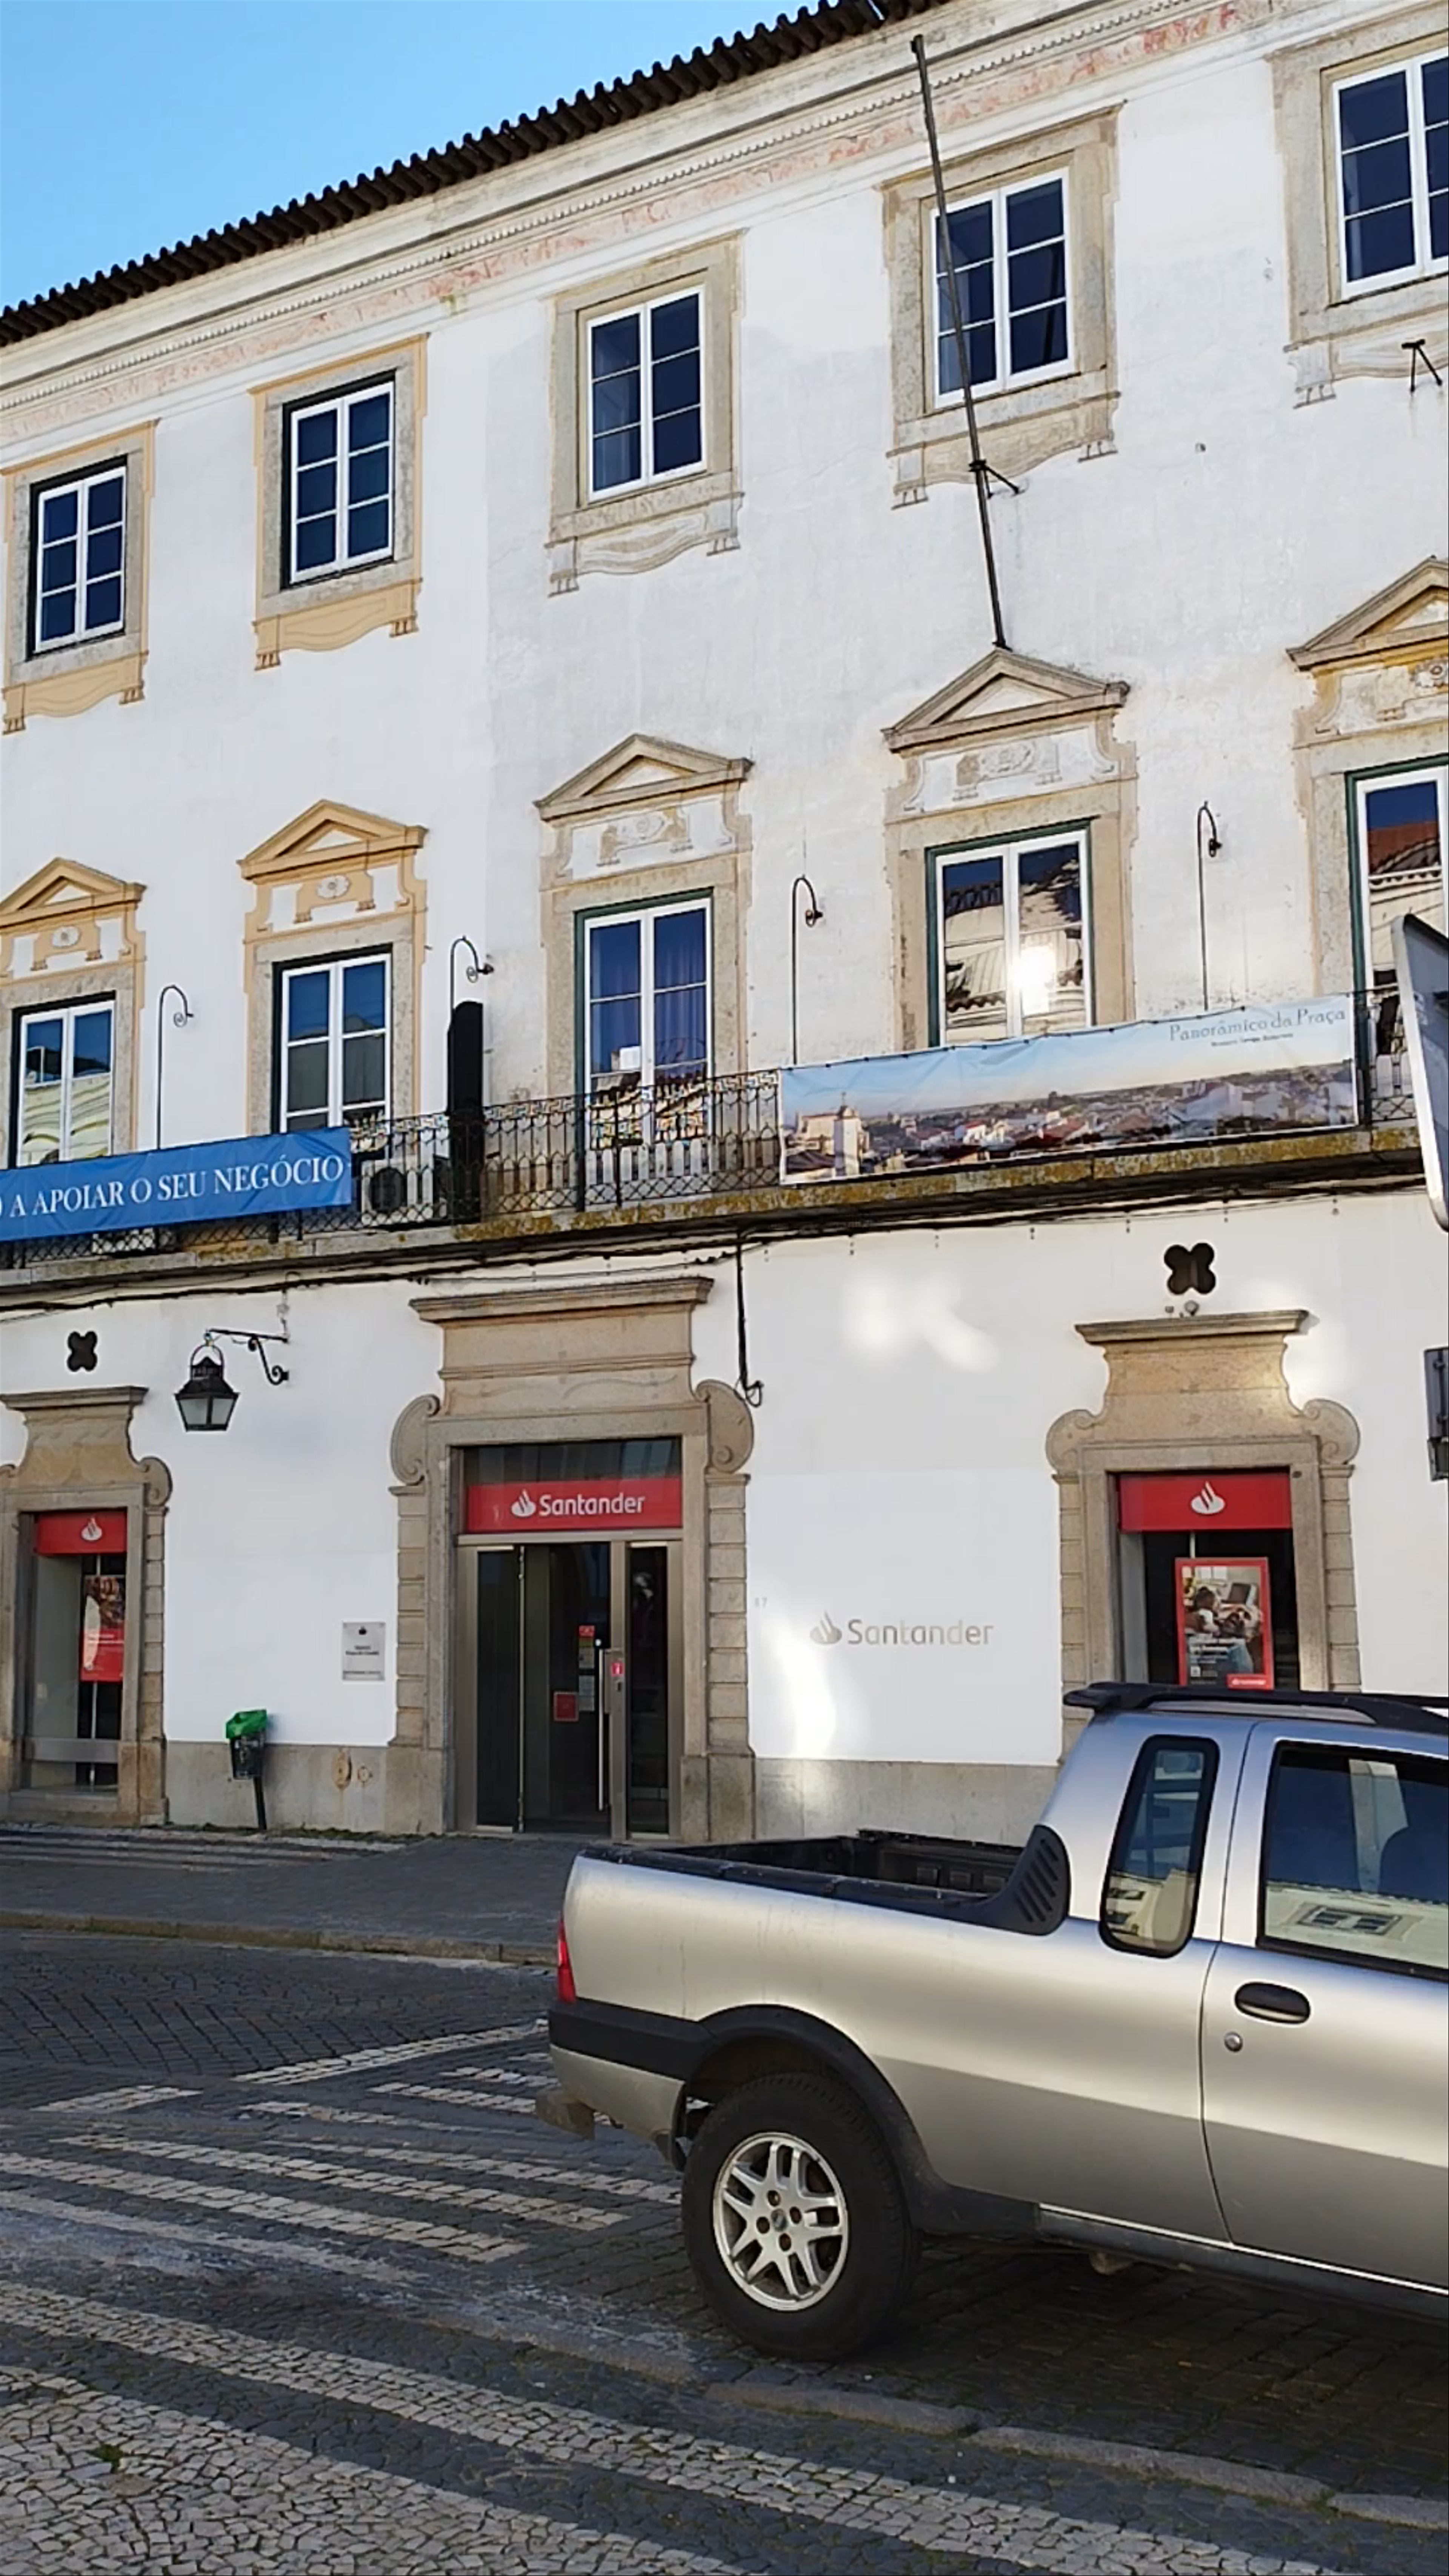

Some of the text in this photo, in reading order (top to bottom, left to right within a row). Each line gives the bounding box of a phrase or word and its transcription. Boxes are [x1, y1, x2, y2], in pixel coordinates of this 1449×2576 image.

[1170, 1019, 1267, 1041] Panorâmico
[1271, 1011, 1292, 1027] da
[1298, 1009, 1346, 1025] Praça
[9, 1194, 26, 1217] A
[31, 1181, 125, 1216] APOIAR
[130, 1177, 152, 1203] O
[157, 1172, 206, 1201] SEU
[214, 1154, 343, 1194] NEGÓCIO
[538, 1492, 646, 1516] Santander
[848, 1618, 994, 1646] Santander
